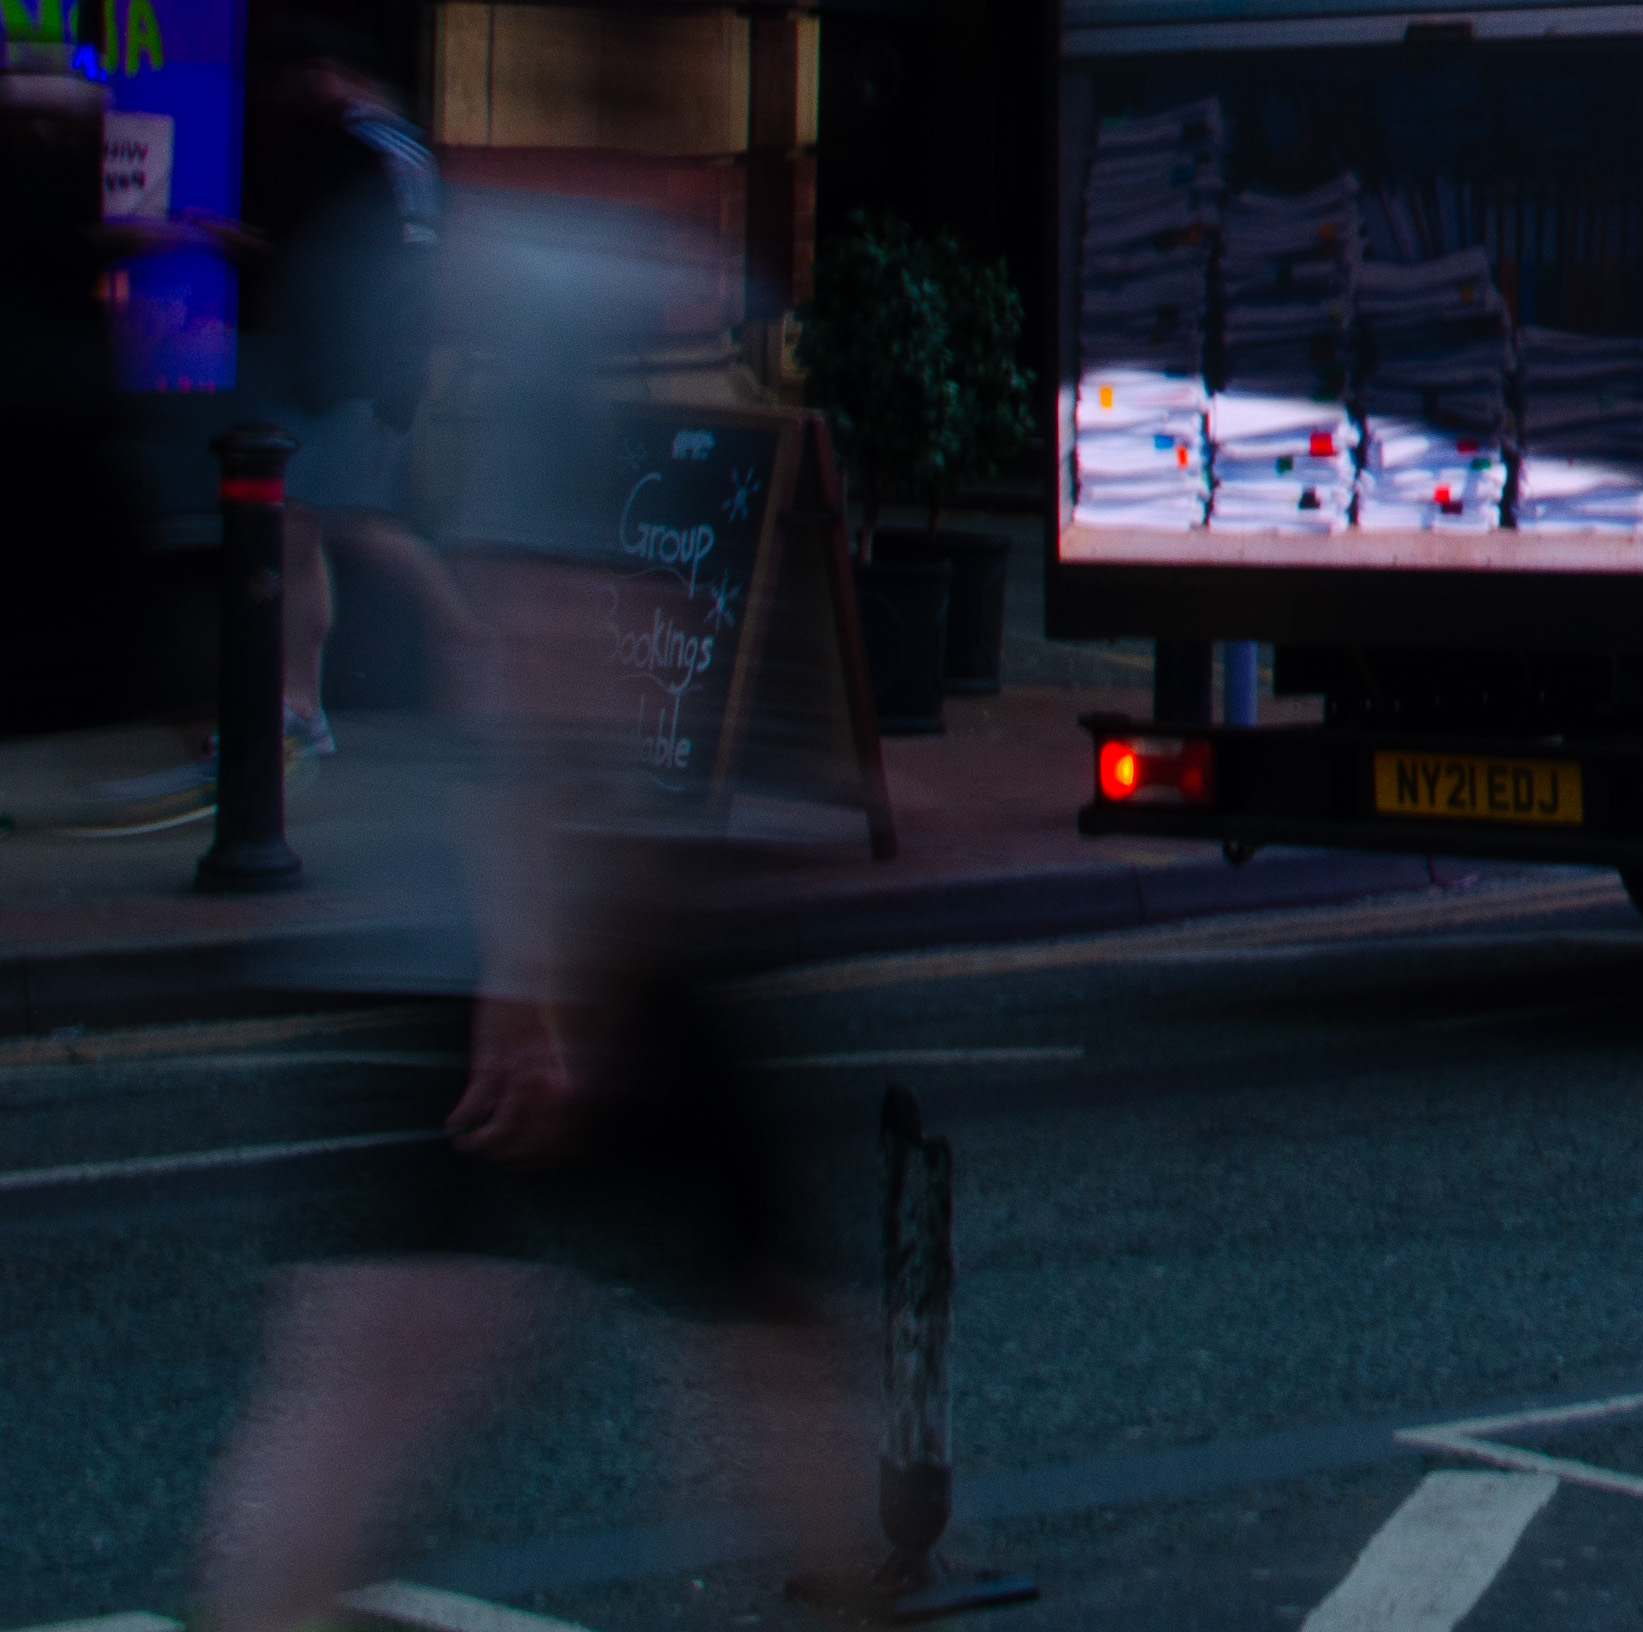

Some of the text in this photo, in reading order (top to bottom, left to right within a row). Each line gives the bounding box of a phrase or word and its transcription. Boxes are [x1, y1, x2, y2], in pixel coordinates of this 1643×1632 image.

[619, 472, 716, 599] Group
[1397, 761, 1559, 814] NY21 EDJ
